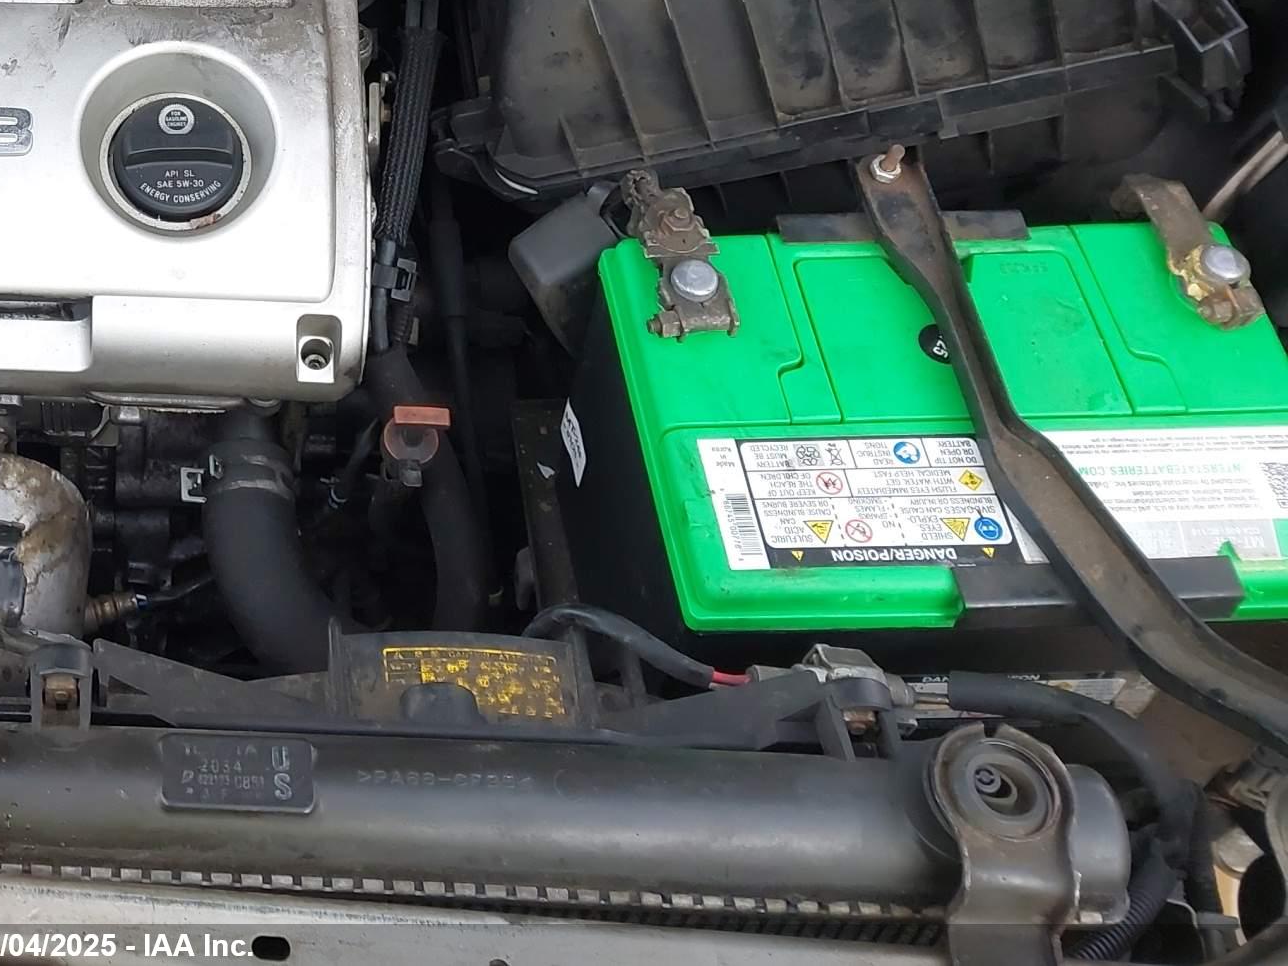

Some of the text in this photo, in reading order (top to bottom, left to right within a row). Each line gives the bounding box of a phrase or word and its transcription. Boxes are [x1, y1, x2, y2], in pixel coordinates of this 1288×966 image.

[165, 169, 195, 178] API SL
[156, 179, 204, 189] SAE 5W-30
[139, 180, 222, 203] ENERGY CONSERVING
[830, 547, 958, 561] DANGER/POISON
